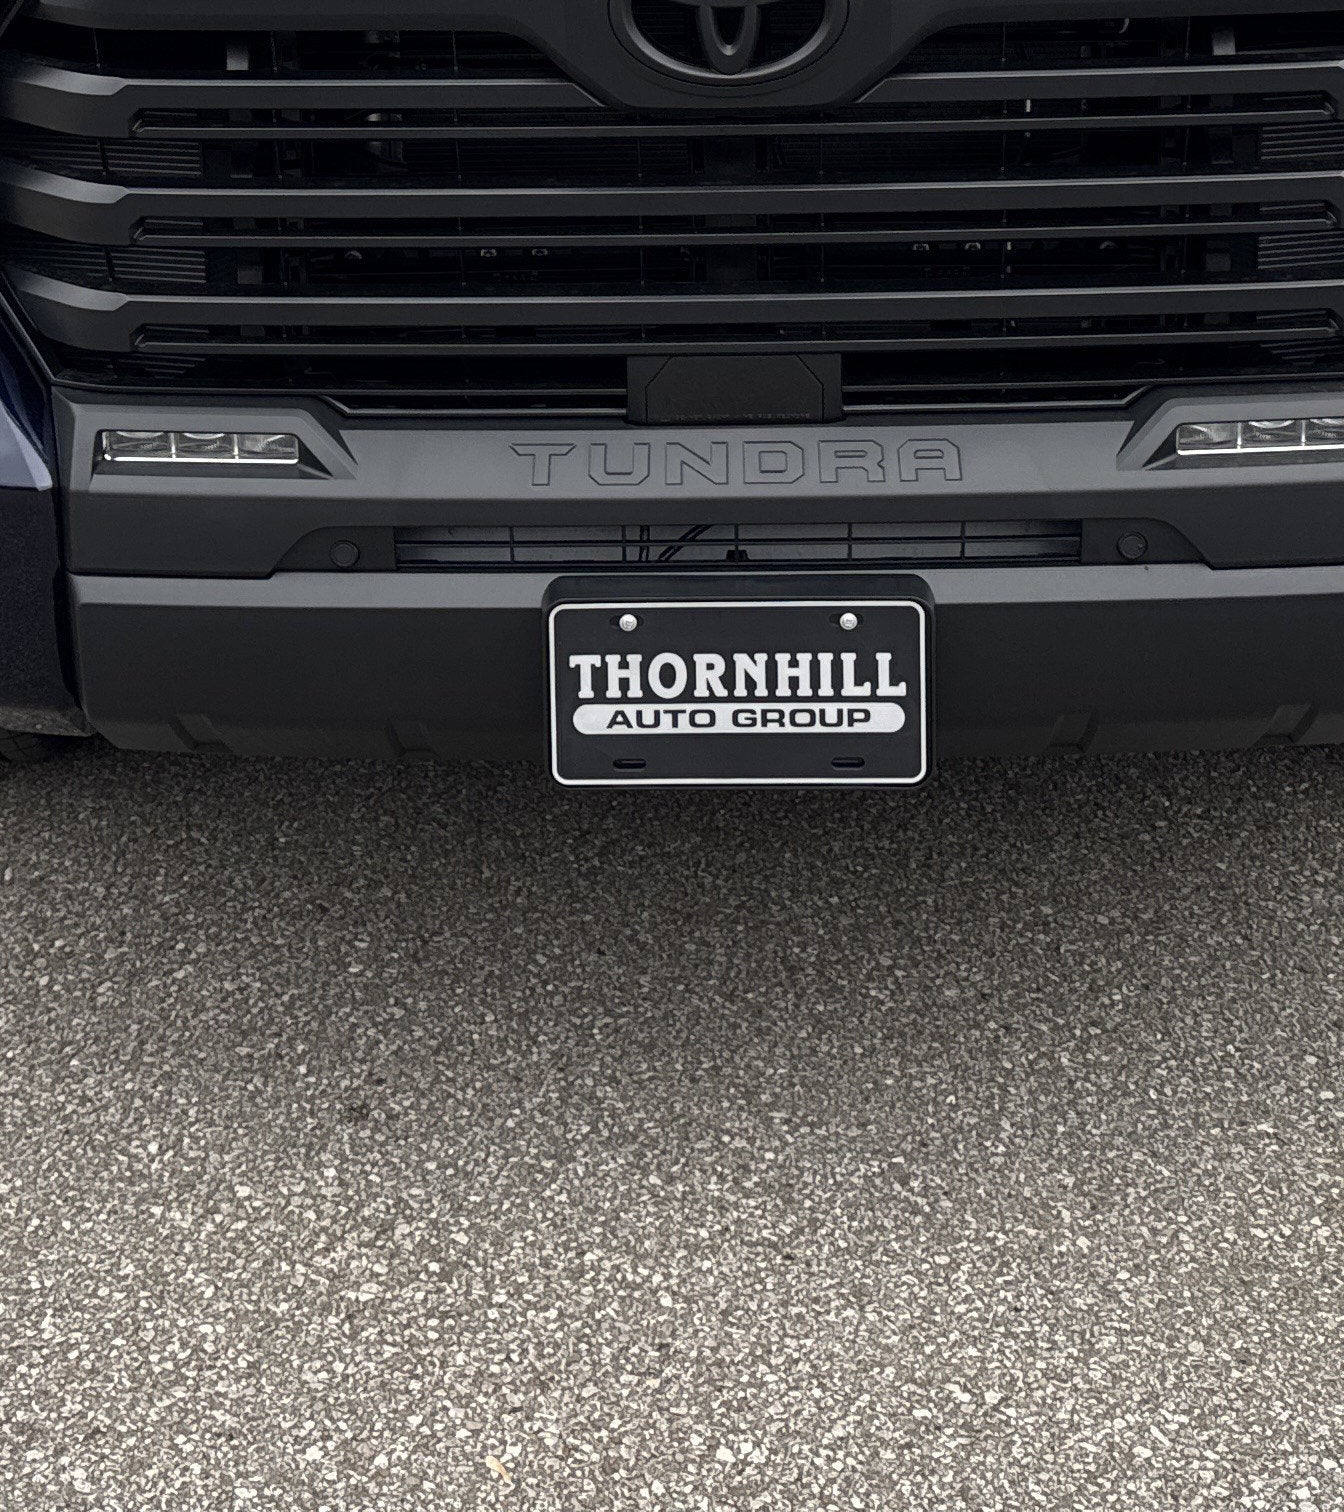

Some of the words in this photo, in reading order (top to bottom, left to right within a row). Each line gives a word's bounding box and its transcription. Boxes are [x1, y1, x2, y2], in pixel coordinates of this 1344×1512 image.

[509, 439, 964, 487] TUNDRA
[569, 651, 907, 699] THORNHILL
[606, 708, 717, 730] AUTO
[731, 707, 872, 729] GROUP
